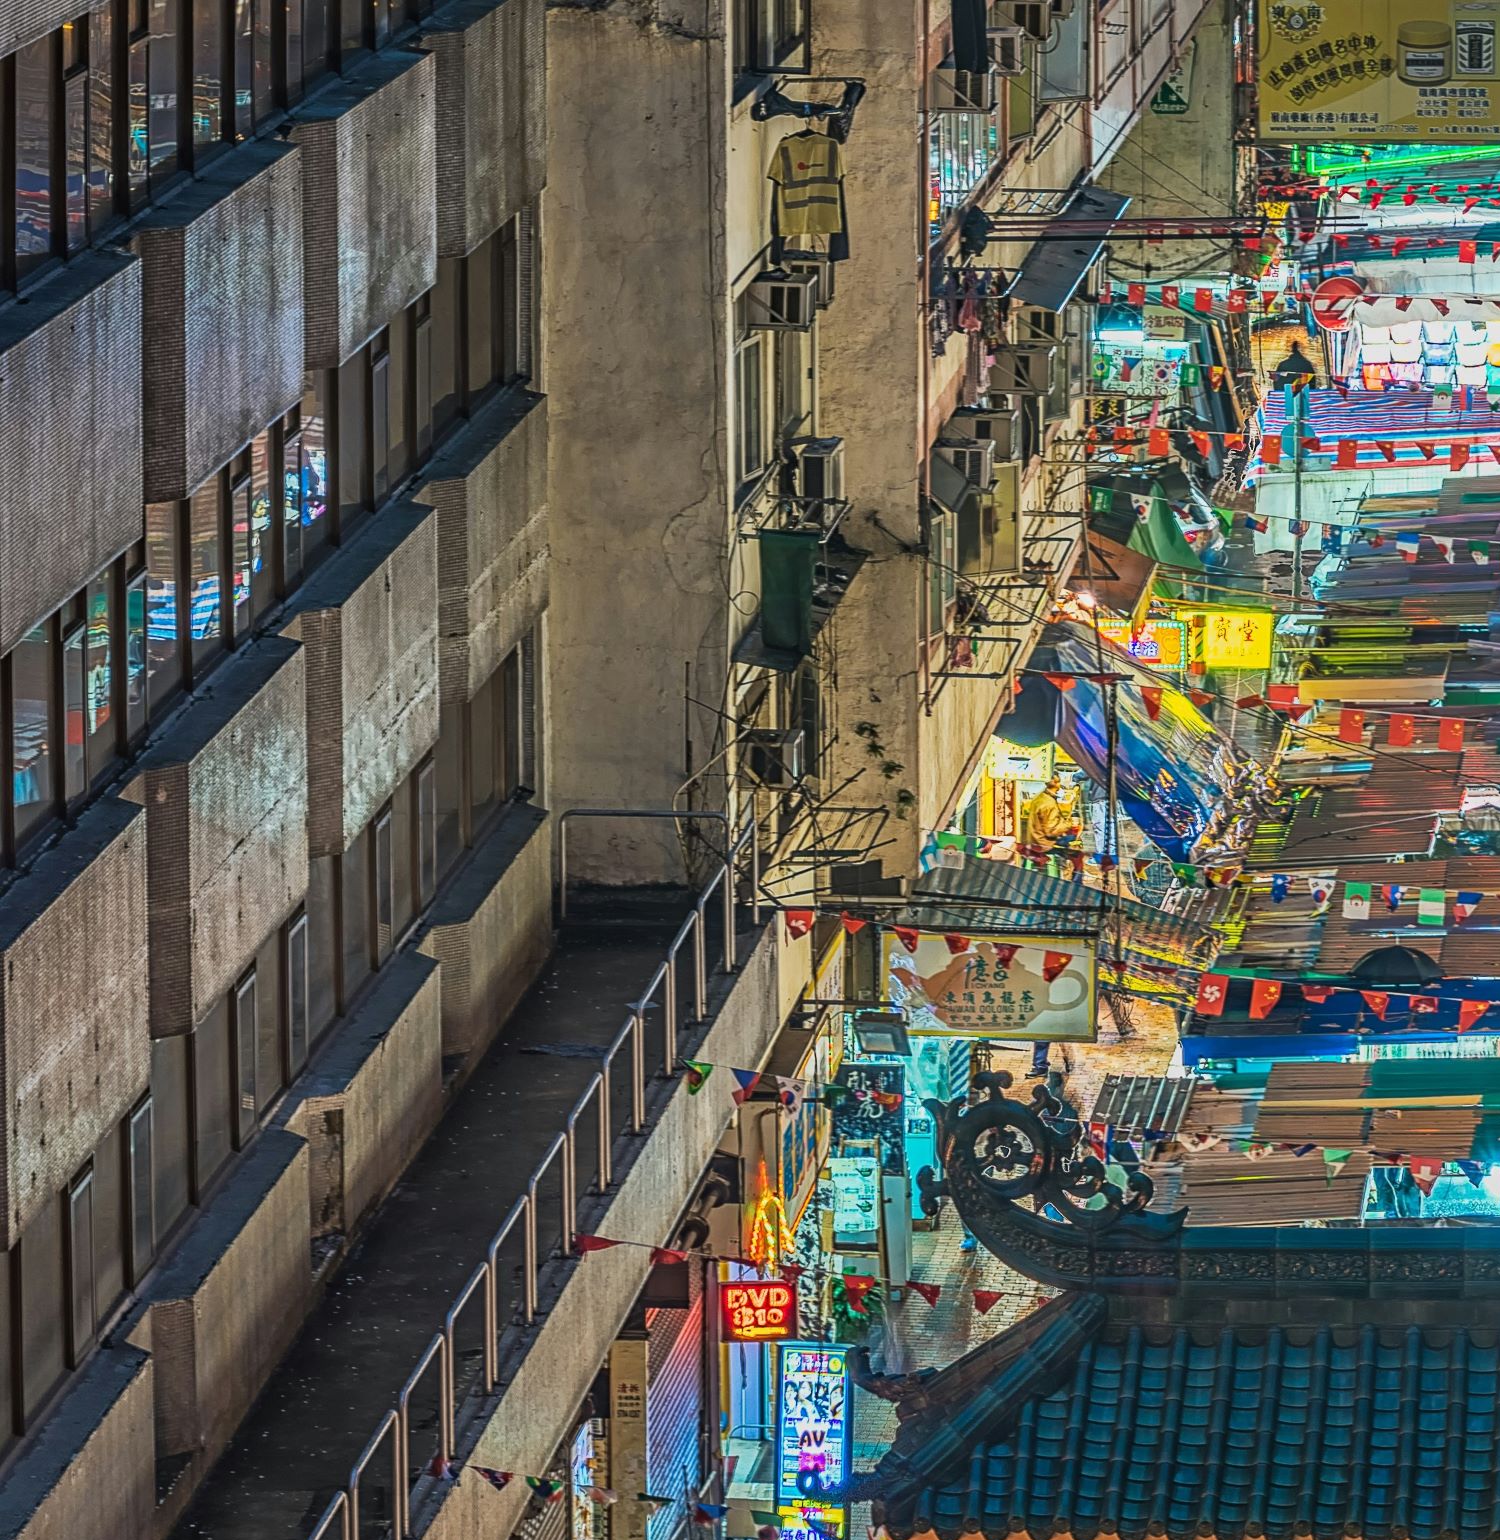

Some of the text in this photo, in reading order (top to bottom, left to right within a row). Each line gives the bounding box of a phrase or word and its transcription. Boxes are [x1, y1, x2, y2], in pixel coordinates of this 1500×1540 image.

[979, 1005, 1015, 1013] OOLONG
[1018, 1005, 1035, 1013] TEA
[727, 1288, 790, 1309] DVD
[733, 1307, 784, 1326] $10
[799, 1430, 826, 1448] AV
